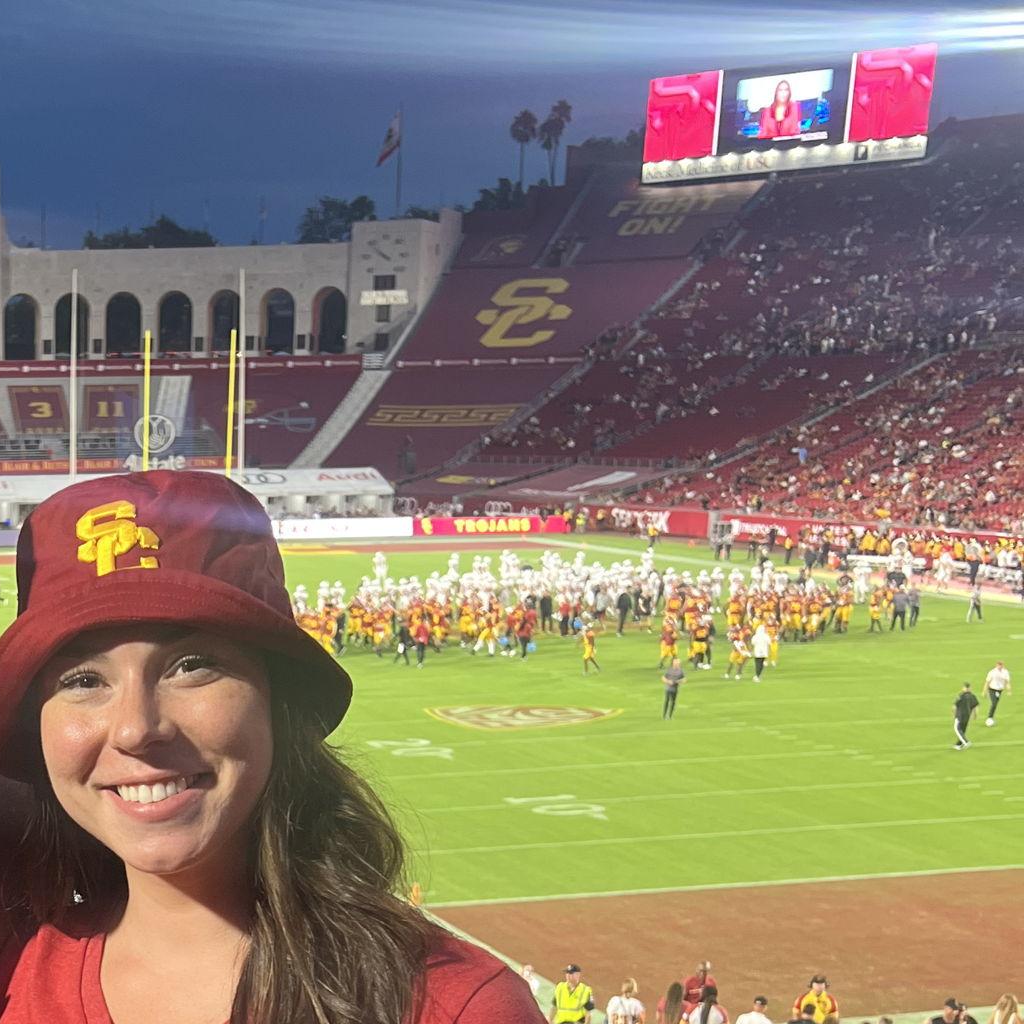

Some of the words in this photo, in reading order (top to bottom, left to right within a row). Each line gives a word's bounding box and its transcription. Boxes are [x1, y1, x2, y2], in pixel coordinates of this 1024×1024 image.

[617, 215, 685, 236] ON!
[28, 401, 53, 418] 3
[96, 401, 125, 417] 11
[317, 470, 377, 482] Audi
[454, 517, 531, 533] TROJANS
